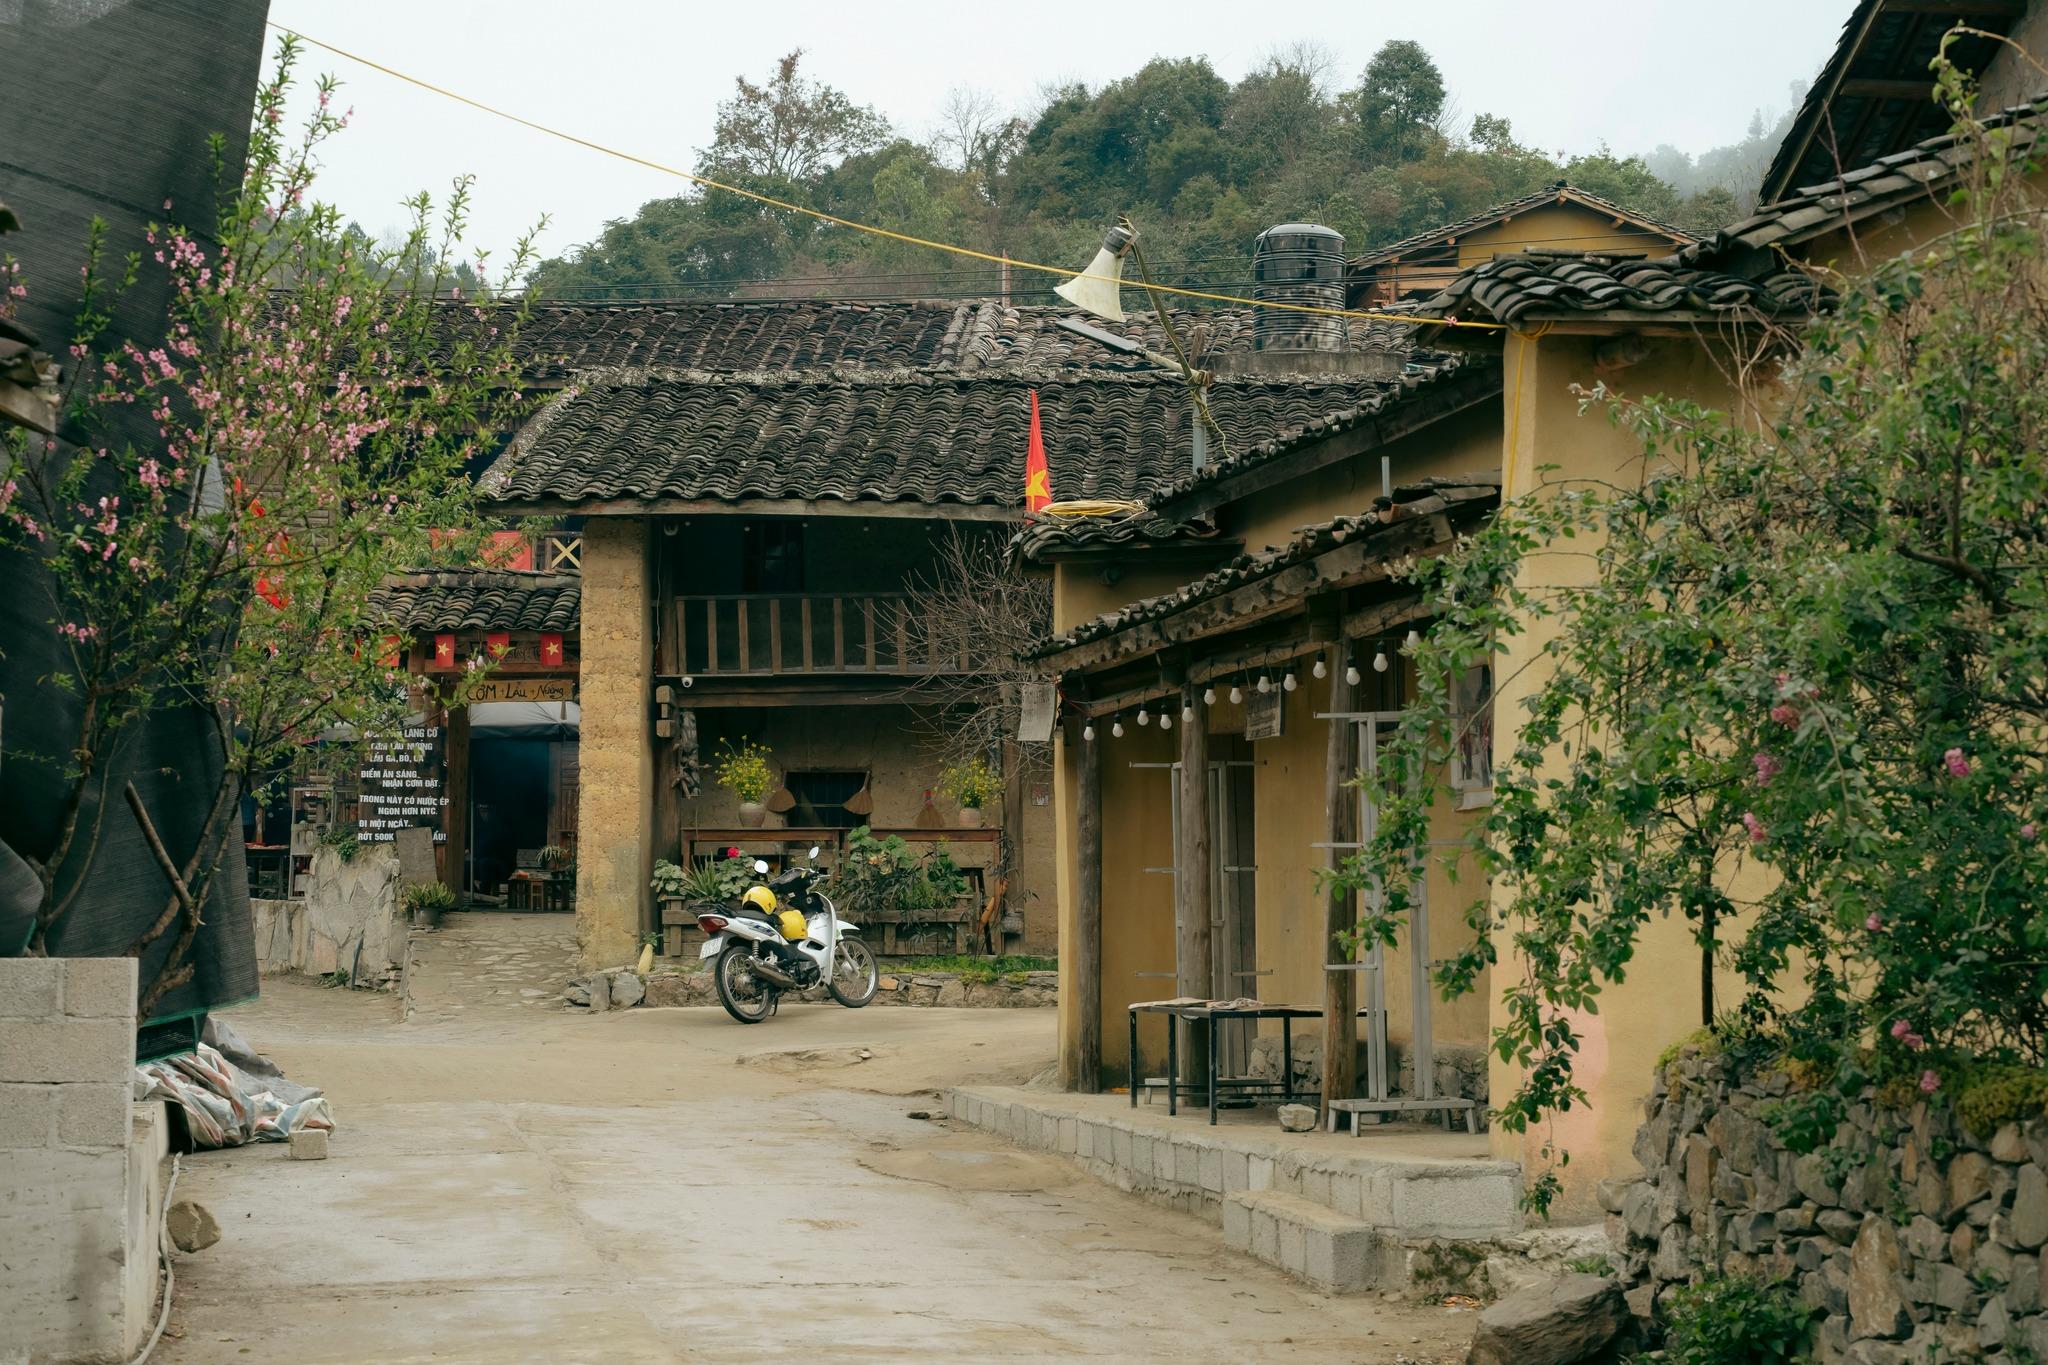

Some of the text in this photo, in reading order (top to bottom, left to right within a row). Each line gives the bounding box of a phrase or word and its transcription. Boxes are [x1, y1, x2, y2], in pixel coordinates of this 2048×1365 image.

[361, 767, 381, 778] ĐIỂM
[383, 778, 403, 789] NHẬN
[406, 779, 423, 788] CƠM
[360, 794, 385, 803] TRONG
[387, 794, 403, 804] NÀY
[405, 795, 415, 805] CÓ
[417, 795, 438, 806] NƯỚC
[378, 807, 400, 815] NGON
[402, 806, 419, 815] HƠN
[369, 818, 386, 830] MỘT
[375, 832, 394, 841] 500K
